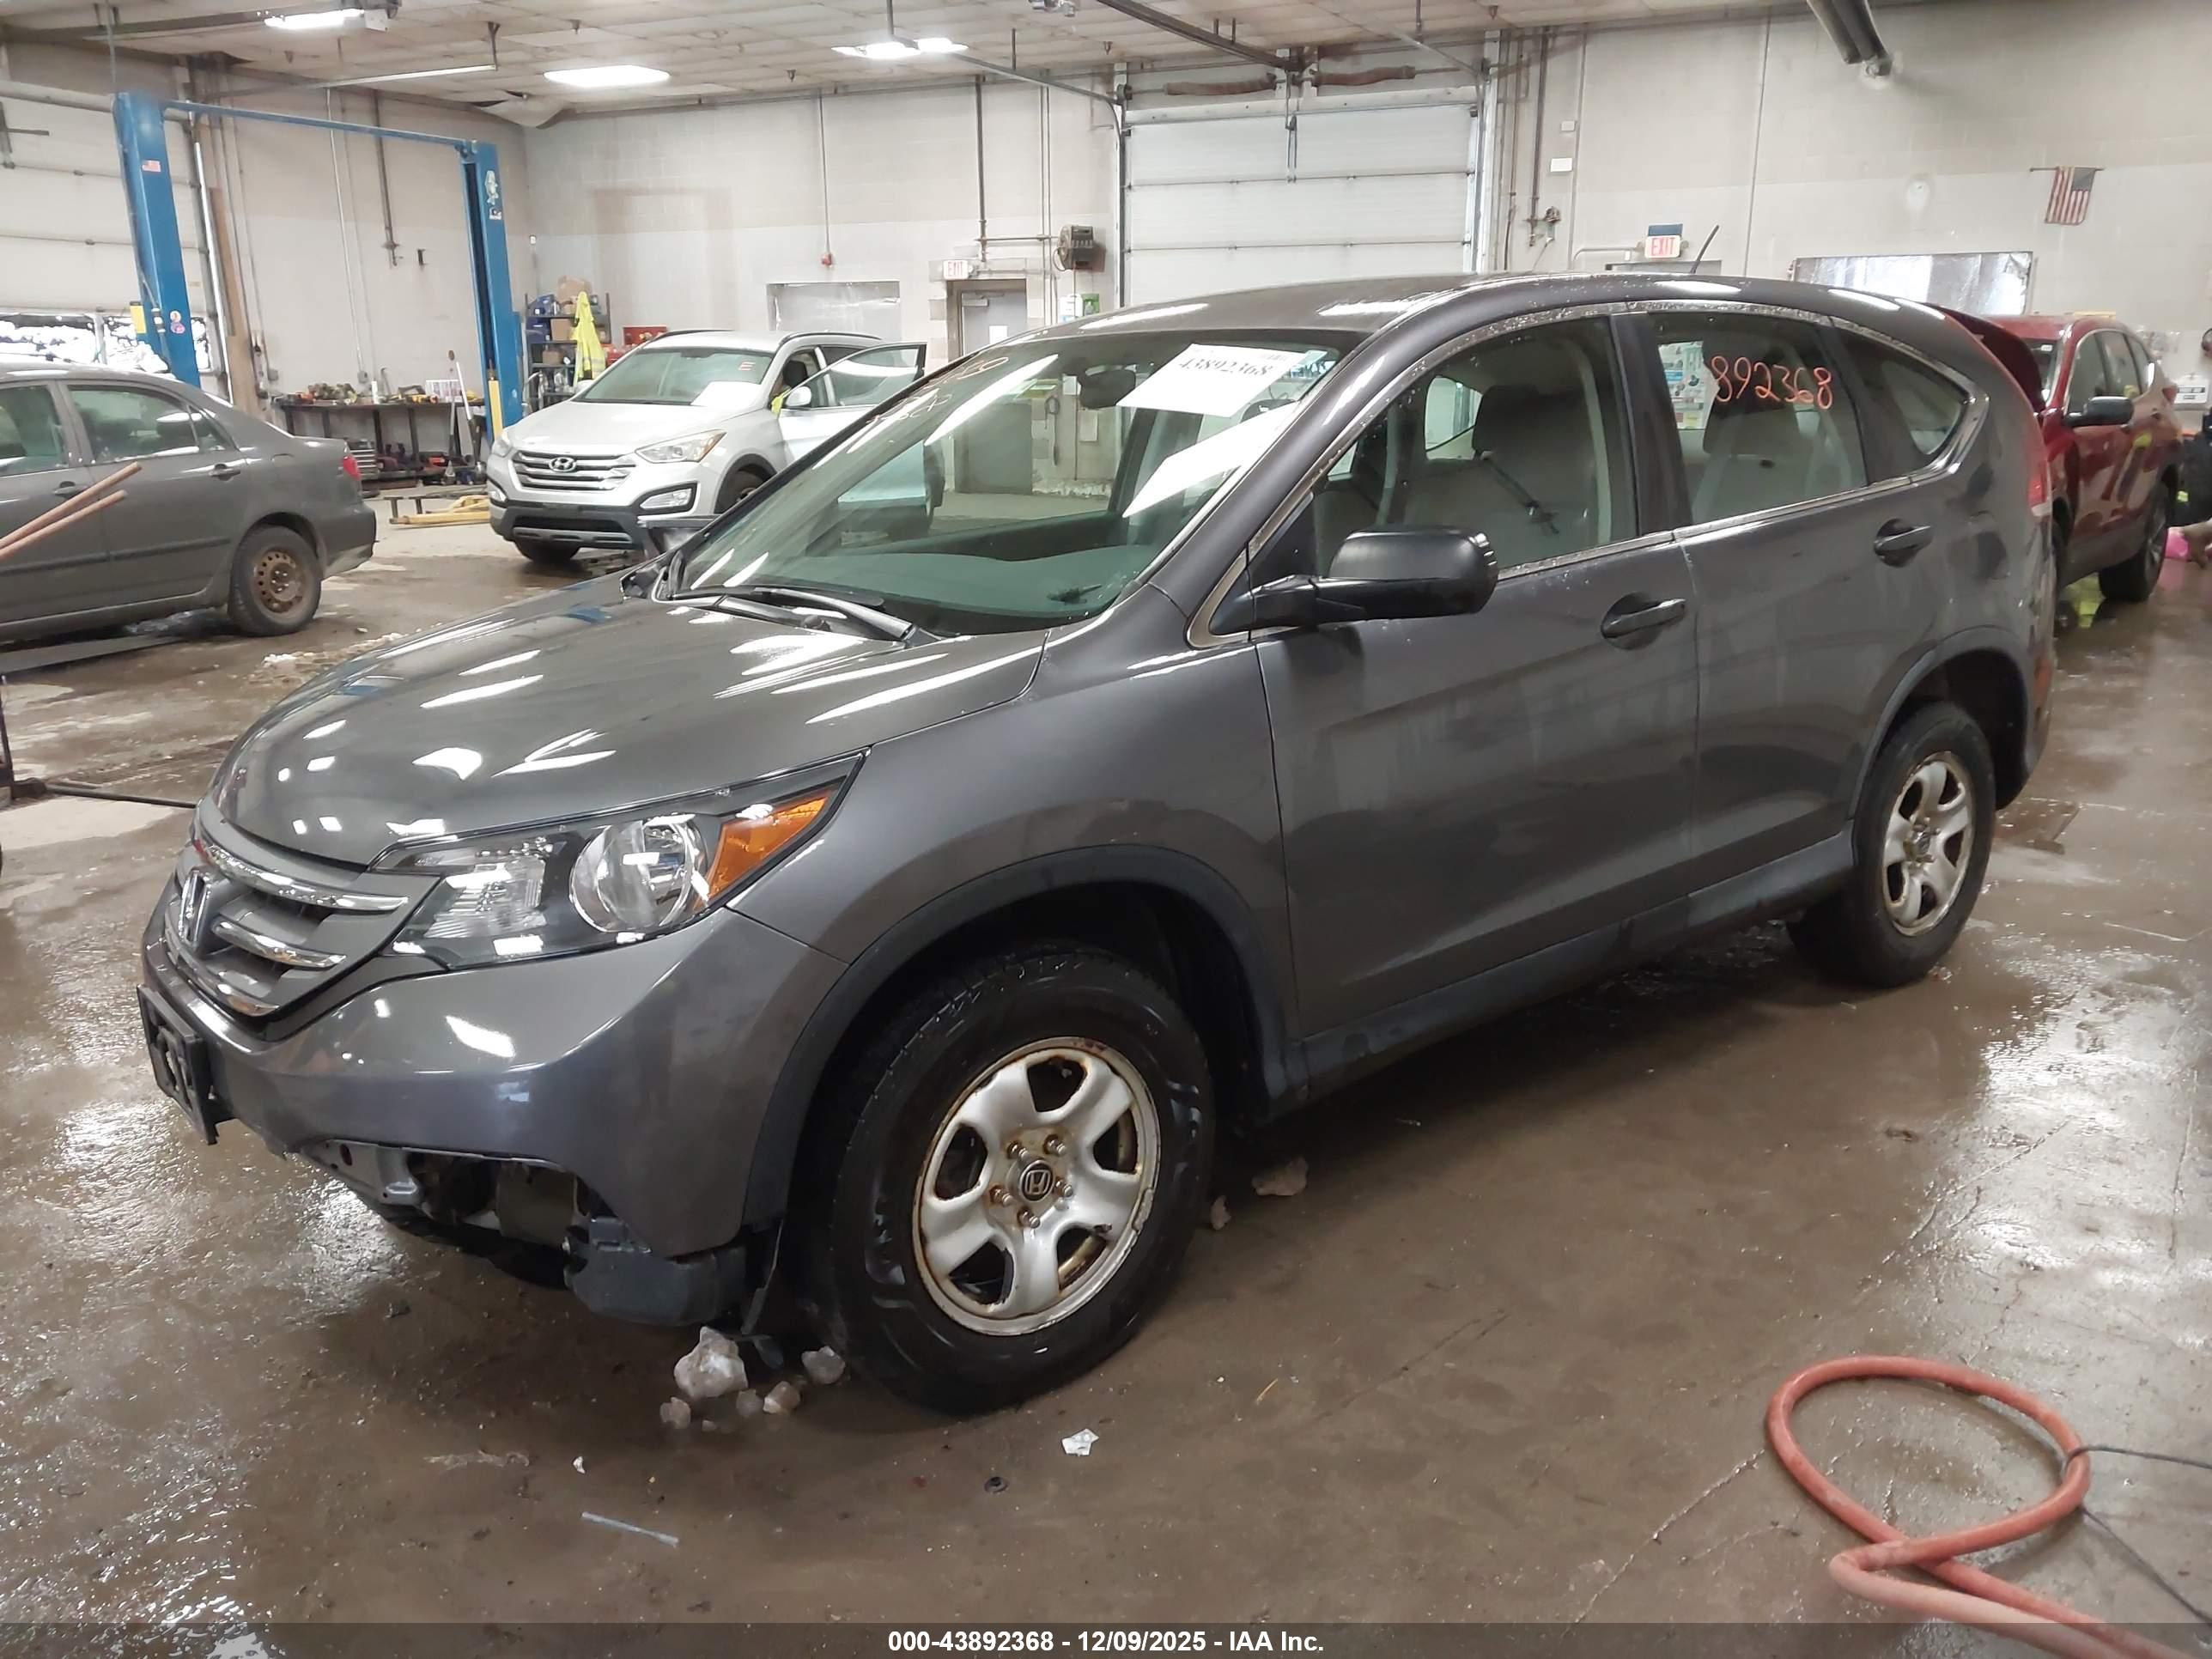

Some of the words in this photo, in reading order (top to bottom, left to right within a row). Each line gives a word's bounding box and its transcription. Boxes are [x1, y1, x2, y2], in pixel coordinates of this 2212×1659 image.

[1651, 237, 1676, 256] EXIT
[1179, 357, 1273, 376] 43892368
[1711, 356, 1833, 410] 892368
